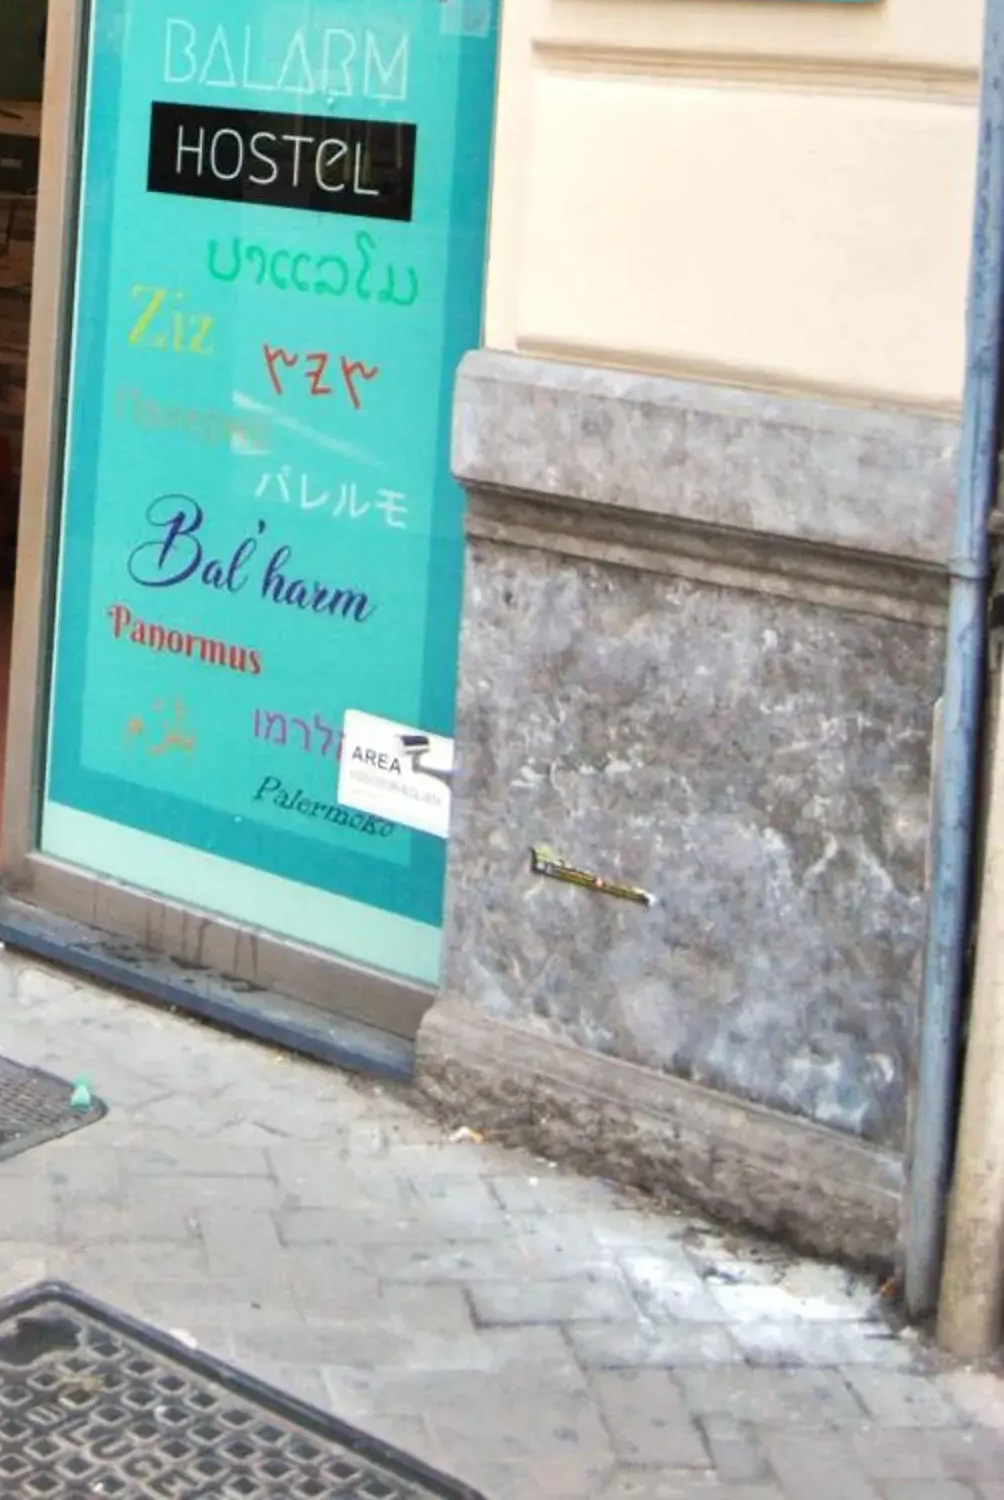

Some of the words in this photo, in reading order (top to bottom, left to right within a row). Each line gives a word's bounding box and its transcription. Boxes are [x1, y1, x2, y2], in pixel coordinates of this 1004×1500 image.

[163, 17, 411, 101] BALARM
[128, 283, 216, 356] Ziz
[107, 604, 263, 676] Panormus
[351, 745, 402, 777] AREA
